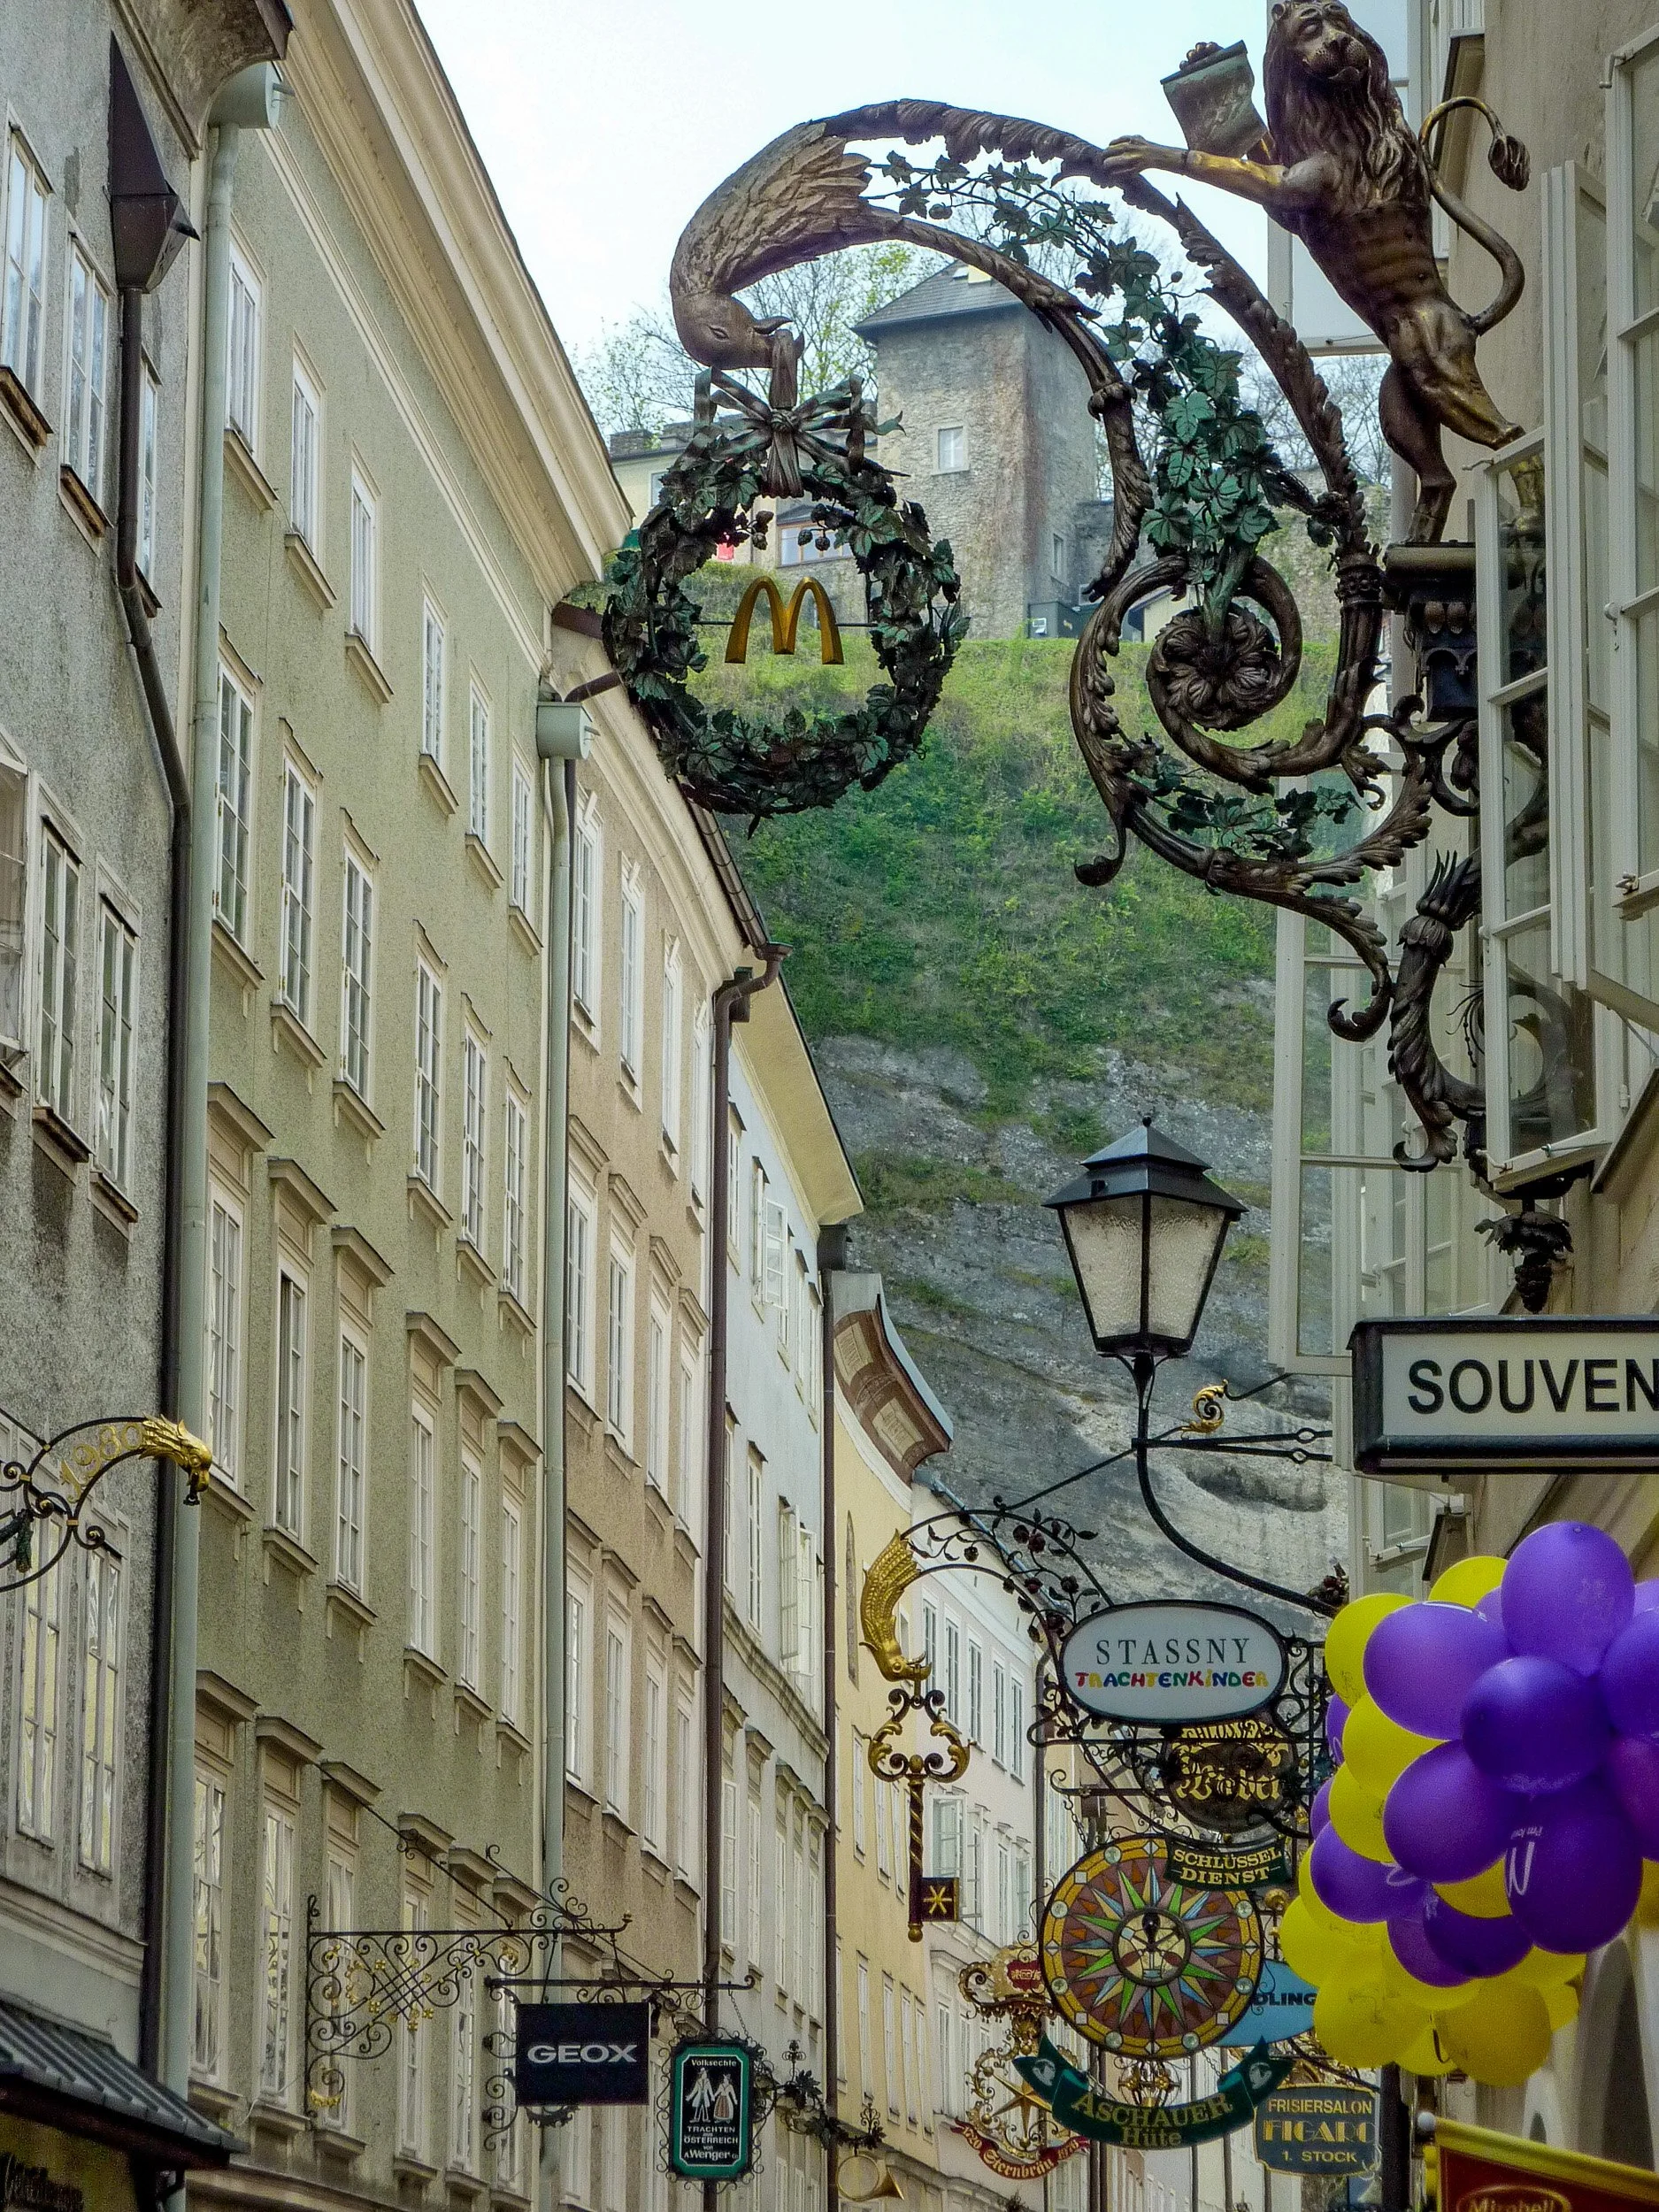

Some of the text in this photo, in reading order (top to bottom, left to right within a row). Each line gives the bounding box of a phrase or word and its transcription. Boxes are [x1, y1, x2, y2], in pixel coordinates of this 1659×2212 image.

[1408, 1359, 1659, 1414] SOUVEN
[1096, 1638, 1250, 1665] STASSNY
[1173, 1847, 1282, 1870] SCHLÜSSEL
[1180, 1866, 1270, 1885] DIENST
[527, 2044, 638, 2063] GEOX
[1071, 2093, 1233, 2127] ASCHAUER
[1269, 2099, 1371, 2114] FRISIERSALON
[683, 2135, 739, 2144] ÖSTERREICH
[1119, 2125, 1182, 2147] Hüte
[1263, 2120, 1377, 2143] FIGARO
[1301, 2151, 1357, 2162] STOCK
